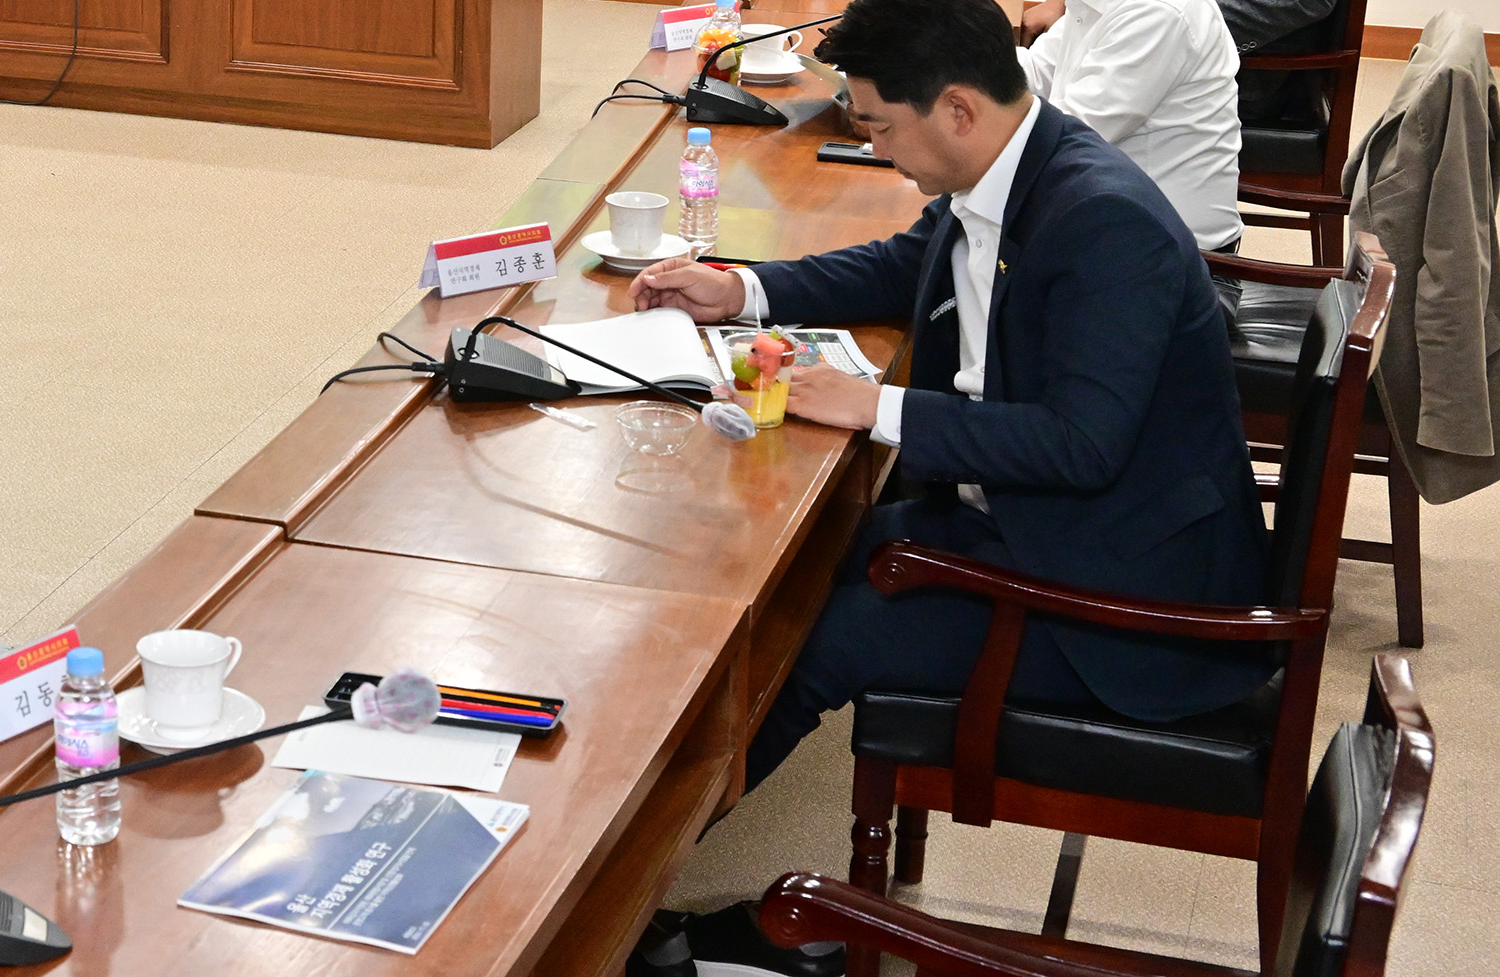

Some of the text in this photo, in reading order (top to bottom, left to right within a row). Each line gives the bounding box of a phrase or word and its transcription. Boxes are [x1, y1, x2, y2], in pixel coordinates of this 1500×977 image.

[494, 252, 546, 277] 김종훈
[365, 841, 392, 859] 연구
[286, 893, 317, 914] 울산
